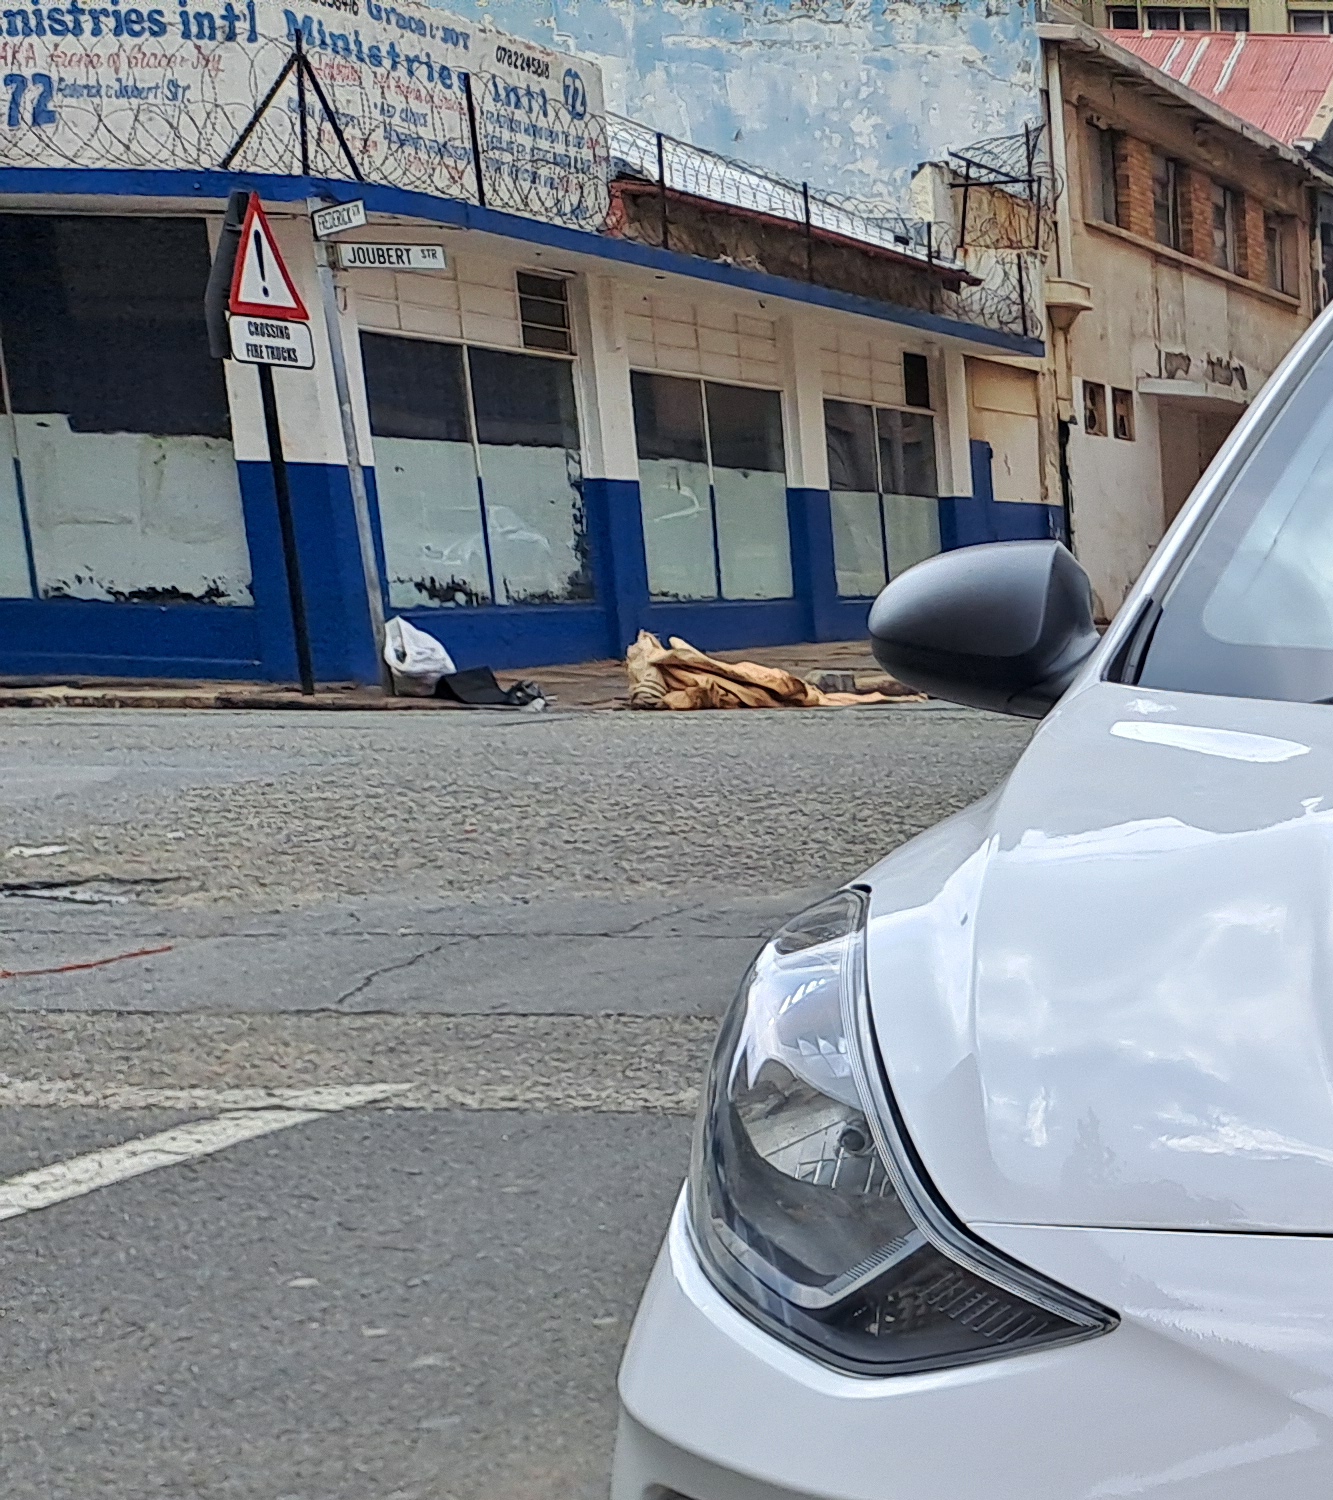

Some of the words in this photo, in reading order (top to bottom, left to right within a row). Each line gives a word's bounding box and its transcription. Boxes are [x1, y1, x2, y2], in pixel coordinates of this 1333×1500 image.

[0, 0, 167, 38] nistries
[4, 73, 57, 127] 72
[347, 247, 412, 266] JOUBERT
[420, 248, 438, 260] STR
[247, 320, 291, 341] CROSSING
[245, 342, 264, 360] FIRE
[265, 345, 299, 364] TRUCKS
